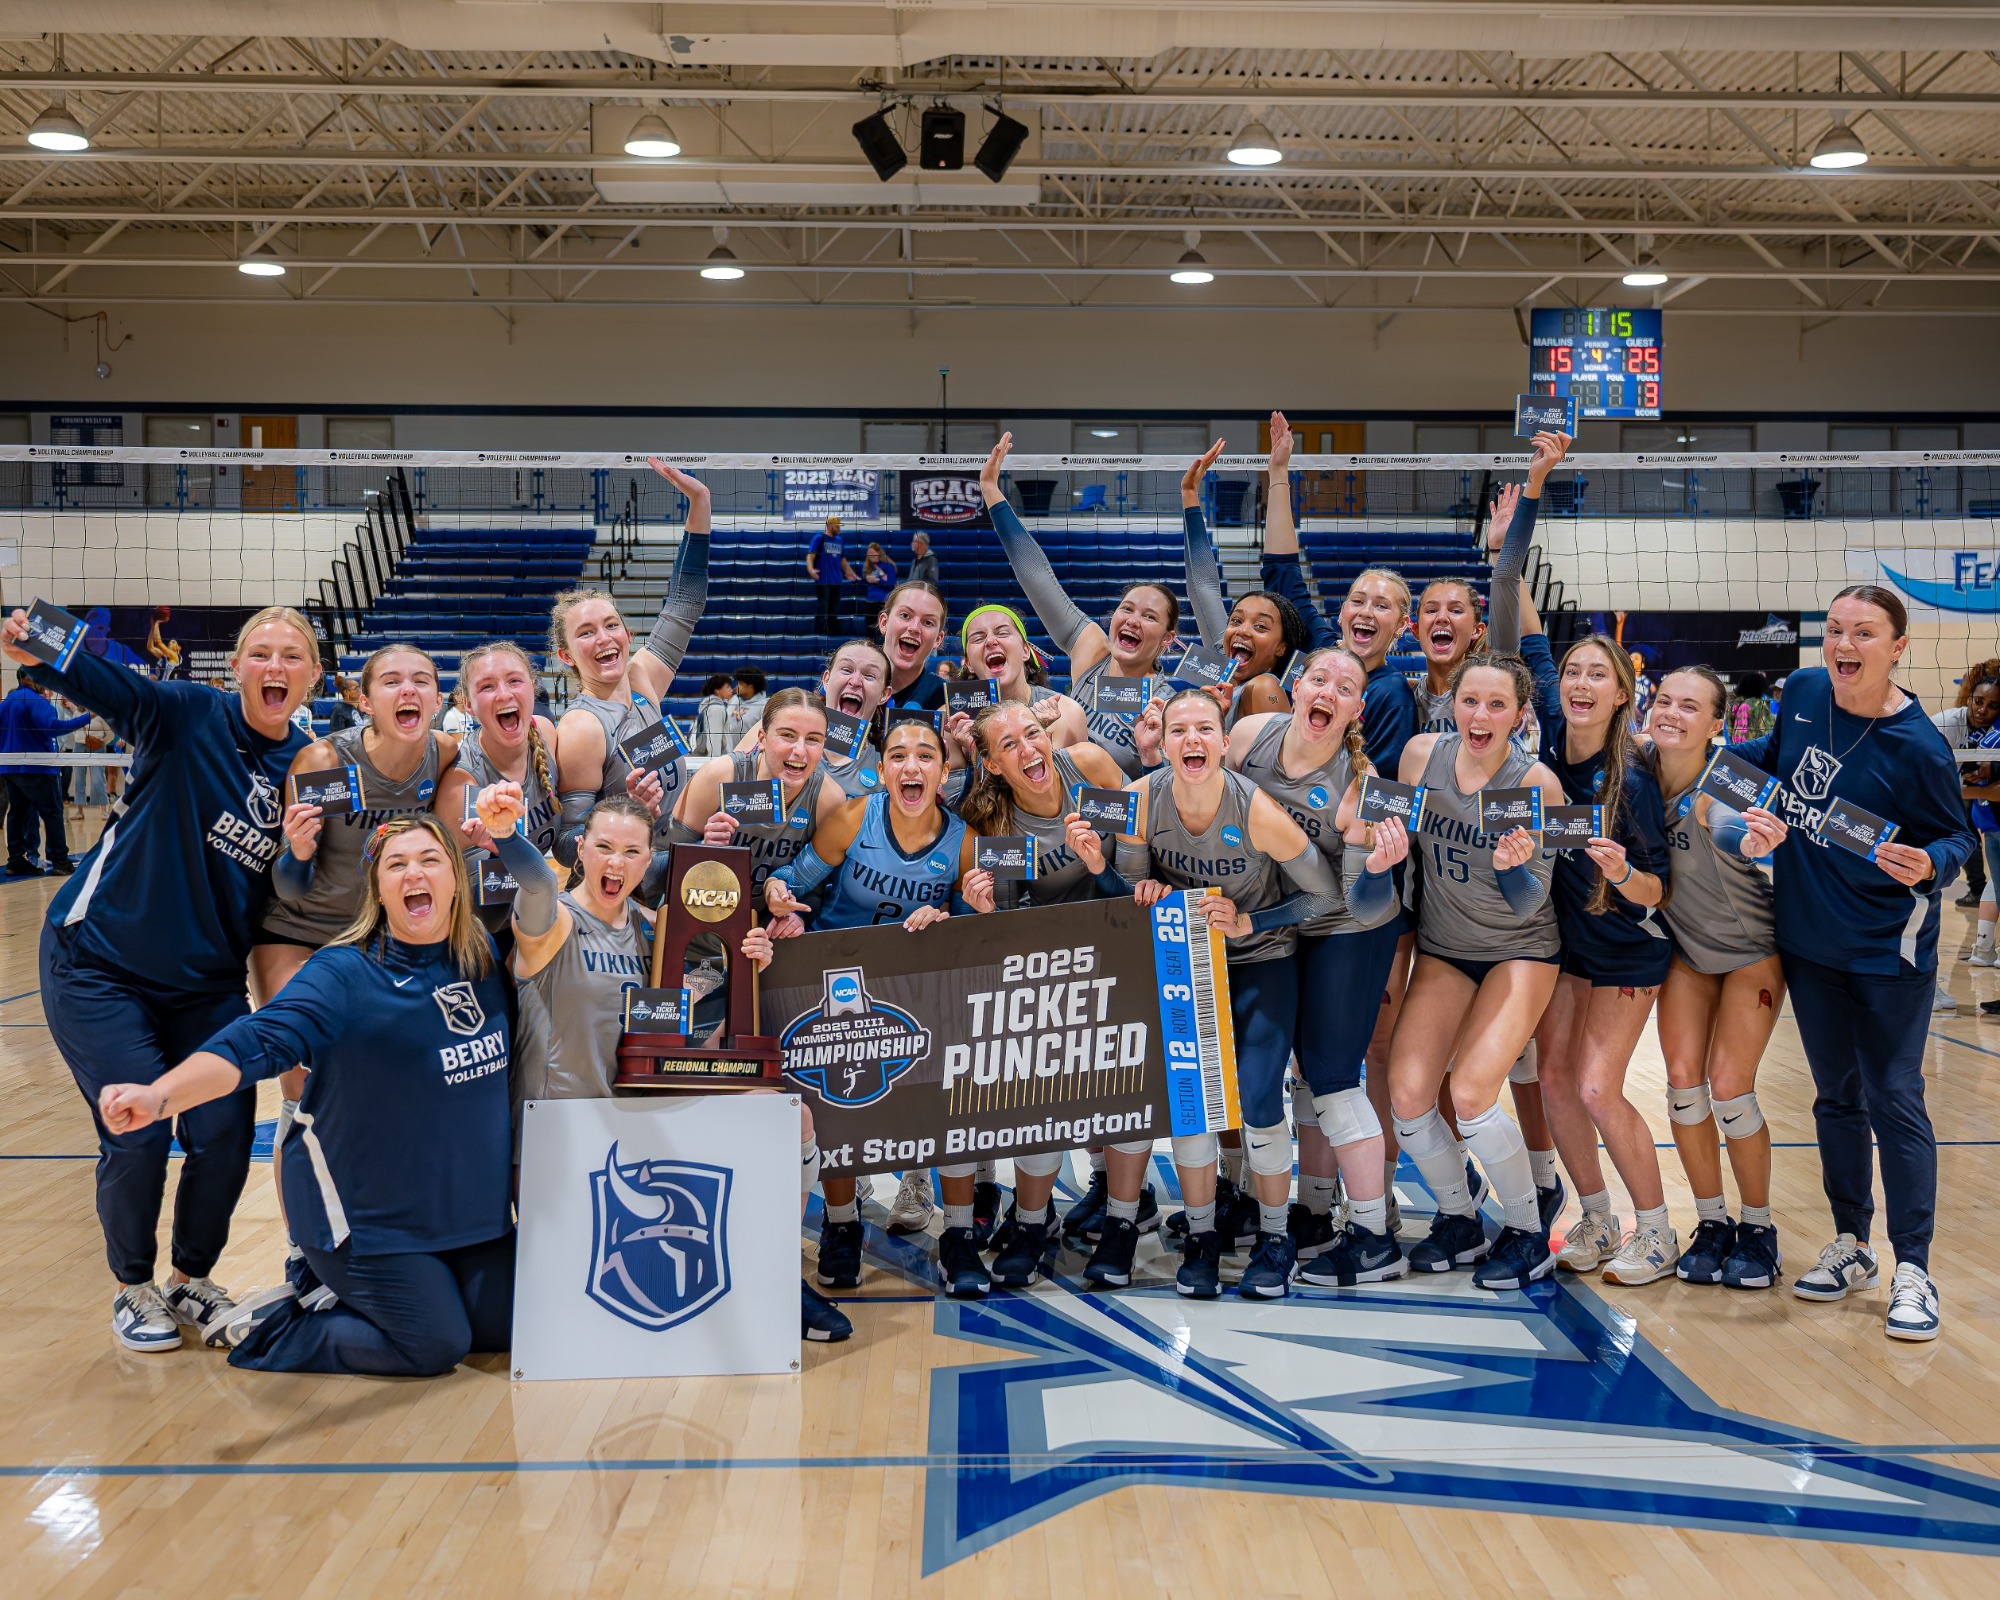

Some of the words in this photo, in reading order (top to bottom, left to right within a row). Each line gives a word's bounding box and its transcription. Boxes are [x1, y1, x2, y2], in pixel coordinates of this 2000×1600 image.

[1533, 338, 1573, 347] MARLINS
[1626, 338, 1655, 347] GUEST
[1550, 347, 1572, 373] 15
[1591, 349, 1603, 364] 4
[1628, 347, 1660, 373] 25
[1583, 364, 1609, 372] BONUS
[1533, 373, 1556, 381] FOULS
[1636, 373, 1660, 381] FOULS
[1644, 382, 1659, 408] 3
[1634, 409, 1660, 417] SCORE
[71, 449, 114, 457] CHAMPIONSHIP
[221, 451, 264, 459] CHAMPIONSHIP
[371, 453, 414, 461] CHAMPIONSHIP
[519, 454, 561, 462] CHAMPIONSHIP
[665, 455, 707, 463] CHAMPIONSHIP
[1676, 455, 1718, 463] CHAMPIONSHIP
[780, 456, 812, 464] VOLLEYBALL
[1069, 457, 1101, 465] VOLLEYBALL
[1214, 457, 1246, 465] VOLLEYBALL
[784, 470, 830, 485] 2025
[832, 469, 876, 487] ECAC
[784, 489, 869, 501] CHAMPIONS
[914, 480, 981, 505] ECAC
[808, 504, 844, 512] DIVISION
[967, 700, 991, 708] PUNCHED
[834, 726, 853, 739] TICKET
[325, 785, 347, 795] TICKET
[1727, 783, 1757, 803] PUNCHED
[1735, 779, 1758, 795] TICKET
[321, 791, 351, 803] PUNCHED
[748, 797, 769, 805] TICKET
[1389, 798, 1409, 808] TICKET
[745, 803, 773, 812] PUNCHED
[1104, 806, 1125, 814] TICKET
[1383, 803, 1412, 816] PUNCHED
[1507, 804, 1529, 812] TICKET
[1100, 812, 1128, 821] PUNCHED
[1503, 810, 1532, 819] PUNCHED
[212, 810, 279, 861] BERRY
[1845, 828, 1876, 846] PUNCHED
[1853, 824, 1876, 839] TICKET
[206, 831, 266, 874] VOLLEYBALL
[929, 859, 947, 871] NCAA
[998, 859, 1026, 867] PUNCHED
[1153, 847, 1247, 877] VIKINGS
[1431, 842, 1471, 885] 15
[852, 860, 947, 903] VIKINGS
[684, 888, 740, 908] NCAA
[1155, 906, 1186, 943] 25
[1002, 945, 1095, 983] 2025
[1167, 948, 1182, 976] SEAT
[835, 988, 858, 998] NCAA
[1162, 983, 1191, 1002] 3
[967, 976, 1117, 1038] TICKET
[650, 1012, 681, 1020] PUNCHED
[1171, 1007, 1188, 1035] ROW
[812, 1020, 850, 1034] 2025
[854, 1017, 885, 1028] DIII
[792, 1031, 843, 1046] WOMEN'S
[845, 1025, 907, 1039] VOLLEYBALL
[438, 1030, 506, 1072] BERRY
[942, 1022, 1148, 1090] PUNCHED
[1168, 1040, 1198, 1071] 12
[444, 1055, 508, 1086] VOLLEYBALL
[663, 1060, 710, 1072] REGIONAL
[710, 1061, 758, 1074] CHAMPION
[1178, 1077, 1197, 1126] SECTION
[863, 1137, 936, 1164] Stop
[945, 1104, 1153, 1155] Bloomington!
